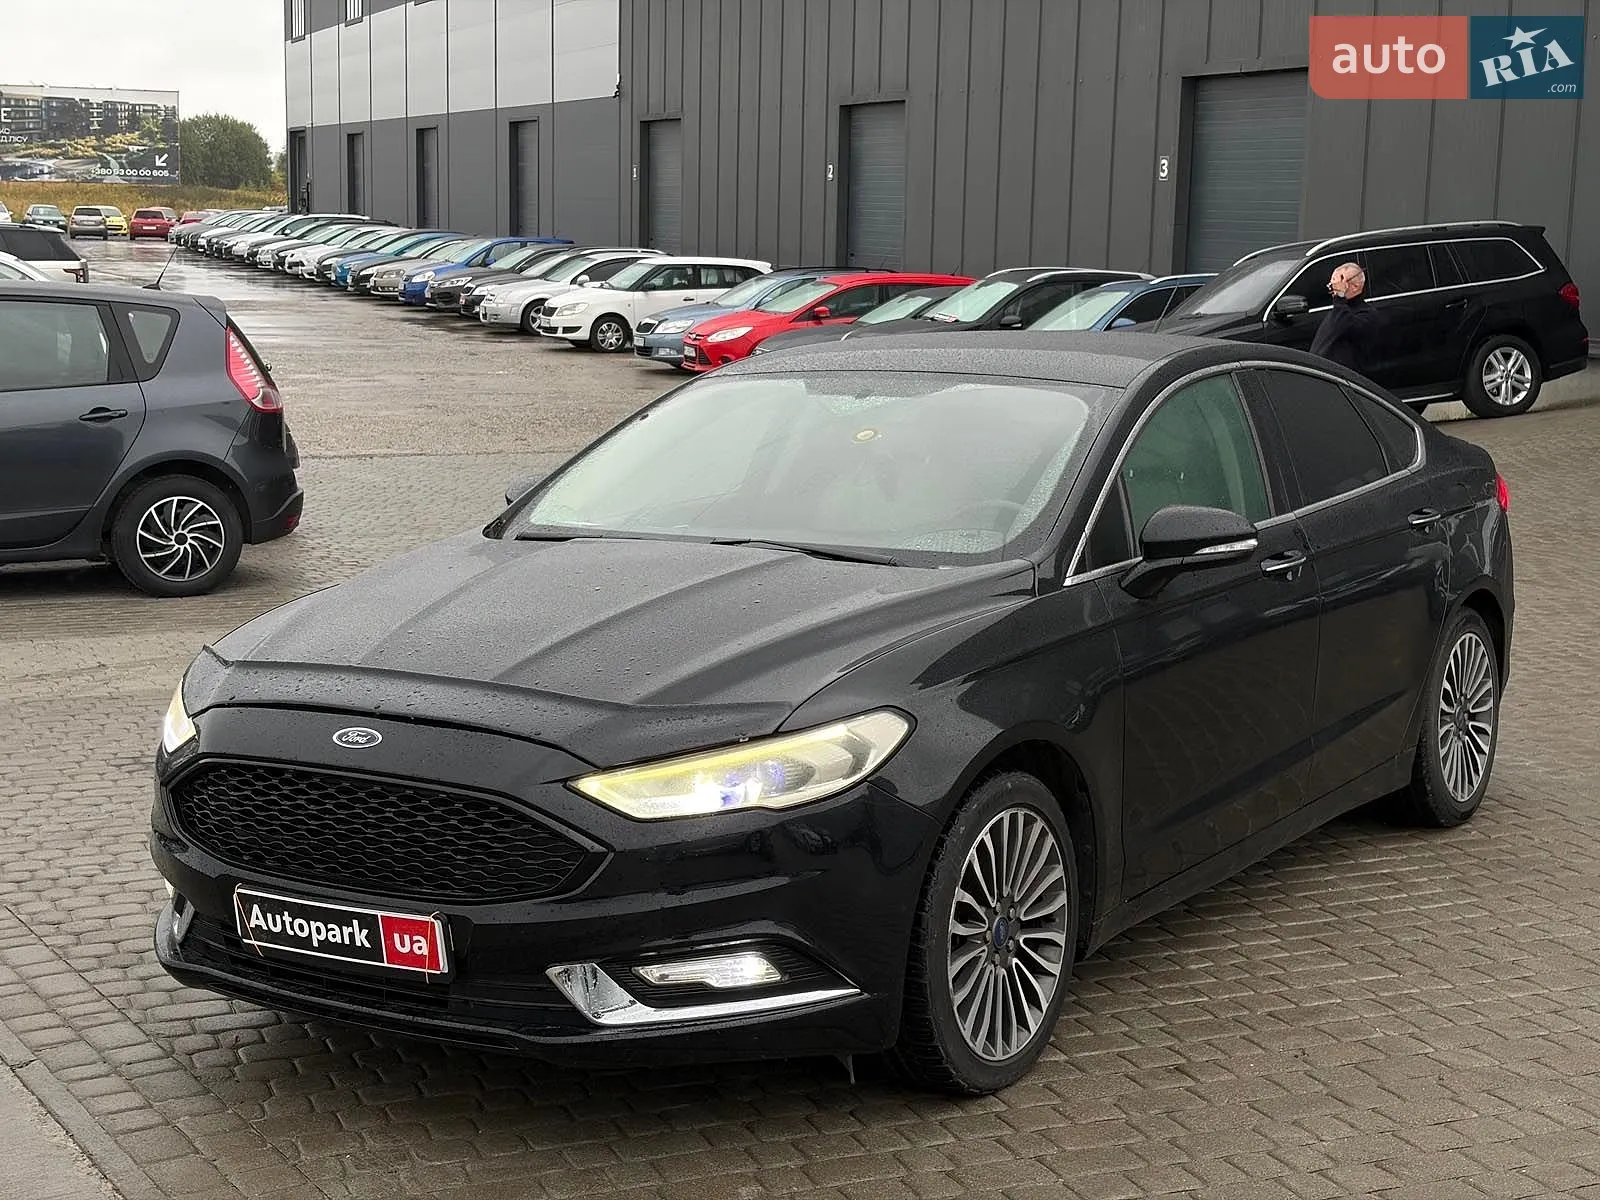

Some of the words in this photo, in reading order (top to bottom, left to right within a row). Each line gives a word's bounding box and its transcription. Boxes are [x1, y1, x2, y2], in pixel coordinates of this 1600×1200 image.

[827, 164, 834, 178] 2
[1160, 159, 1168, 177] 3
[250, 903, 372, 949] Autopark
[393, 931, 429, 956] ua
